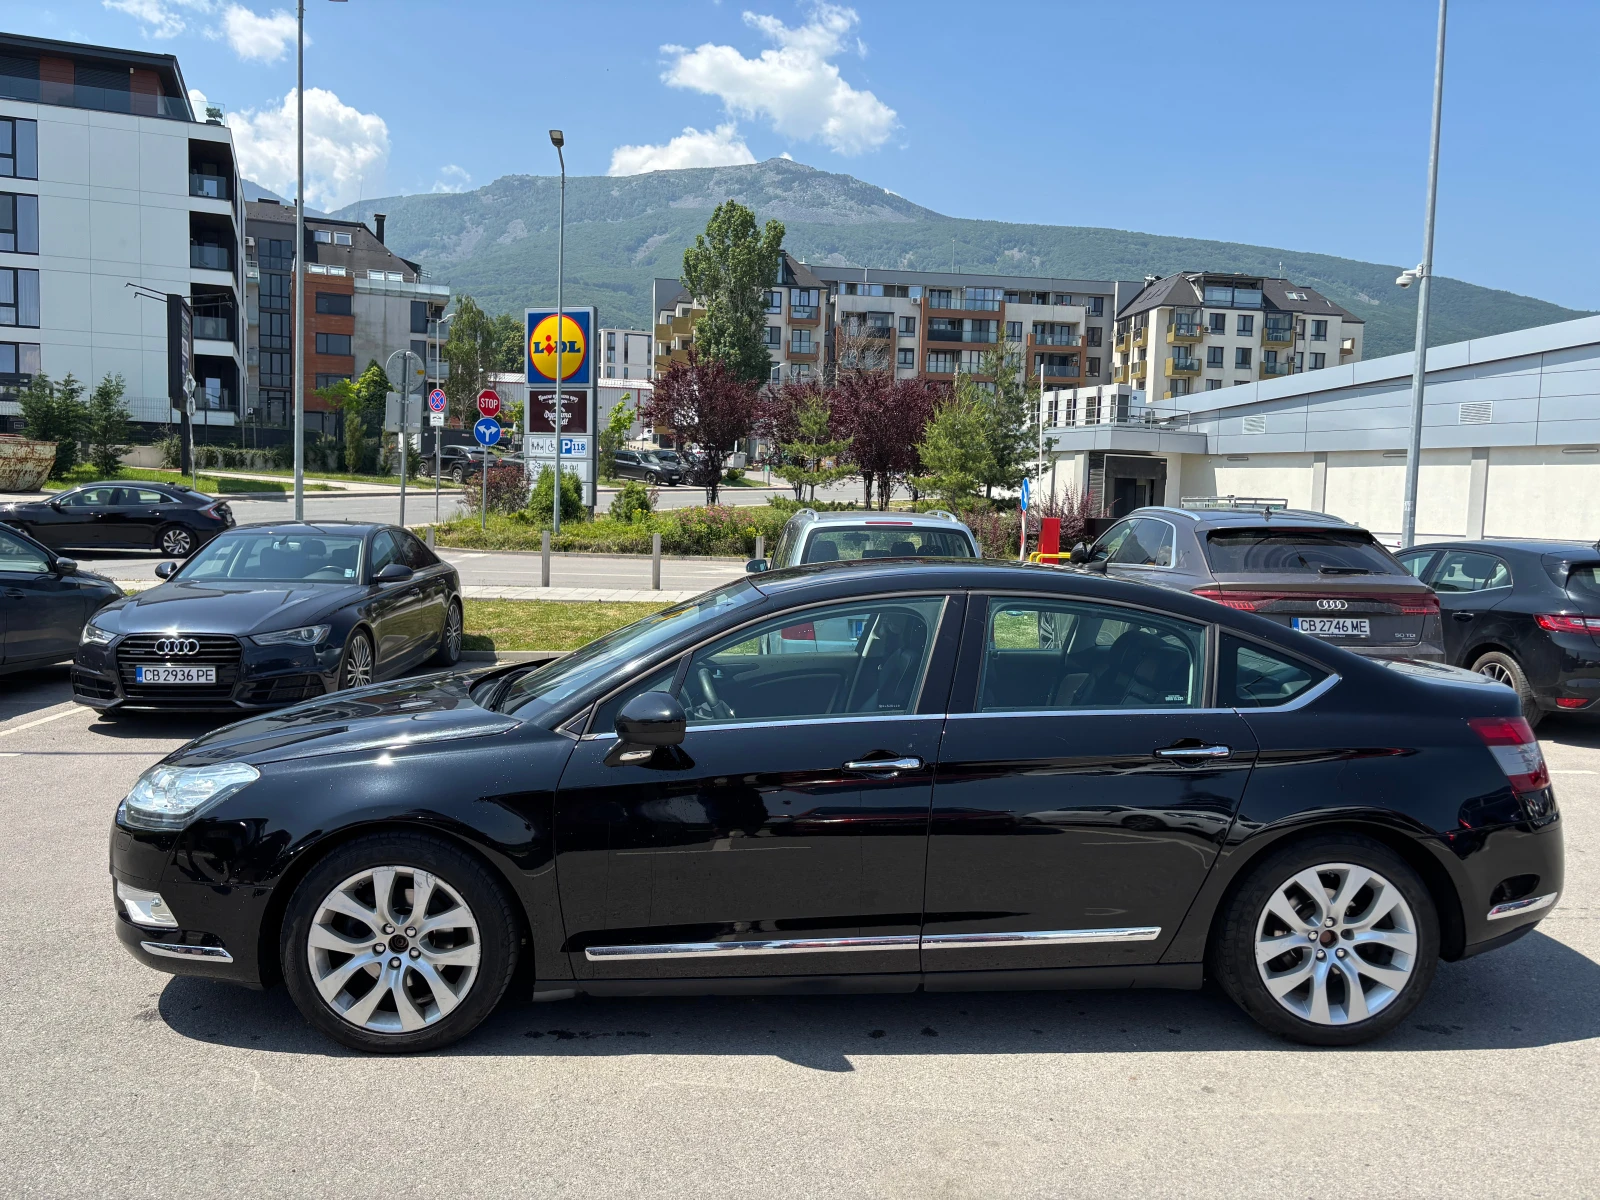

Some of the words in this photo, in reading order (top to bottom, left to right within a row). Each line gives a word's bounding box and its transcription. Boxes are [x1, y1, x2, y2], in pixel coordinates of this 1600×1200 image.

[480, 398, 498, 409] STOP
[572, 443, 586, 451] 118
[1301, 620, 1316, 632] CB
[1319, 620, 1348, 632] 2746
[1351, 620, 1367, 633] ME
[144, 669, 160, 681] CB
[163, 669, 193, 681] 2936
[196, 669, 213, 681] PE
